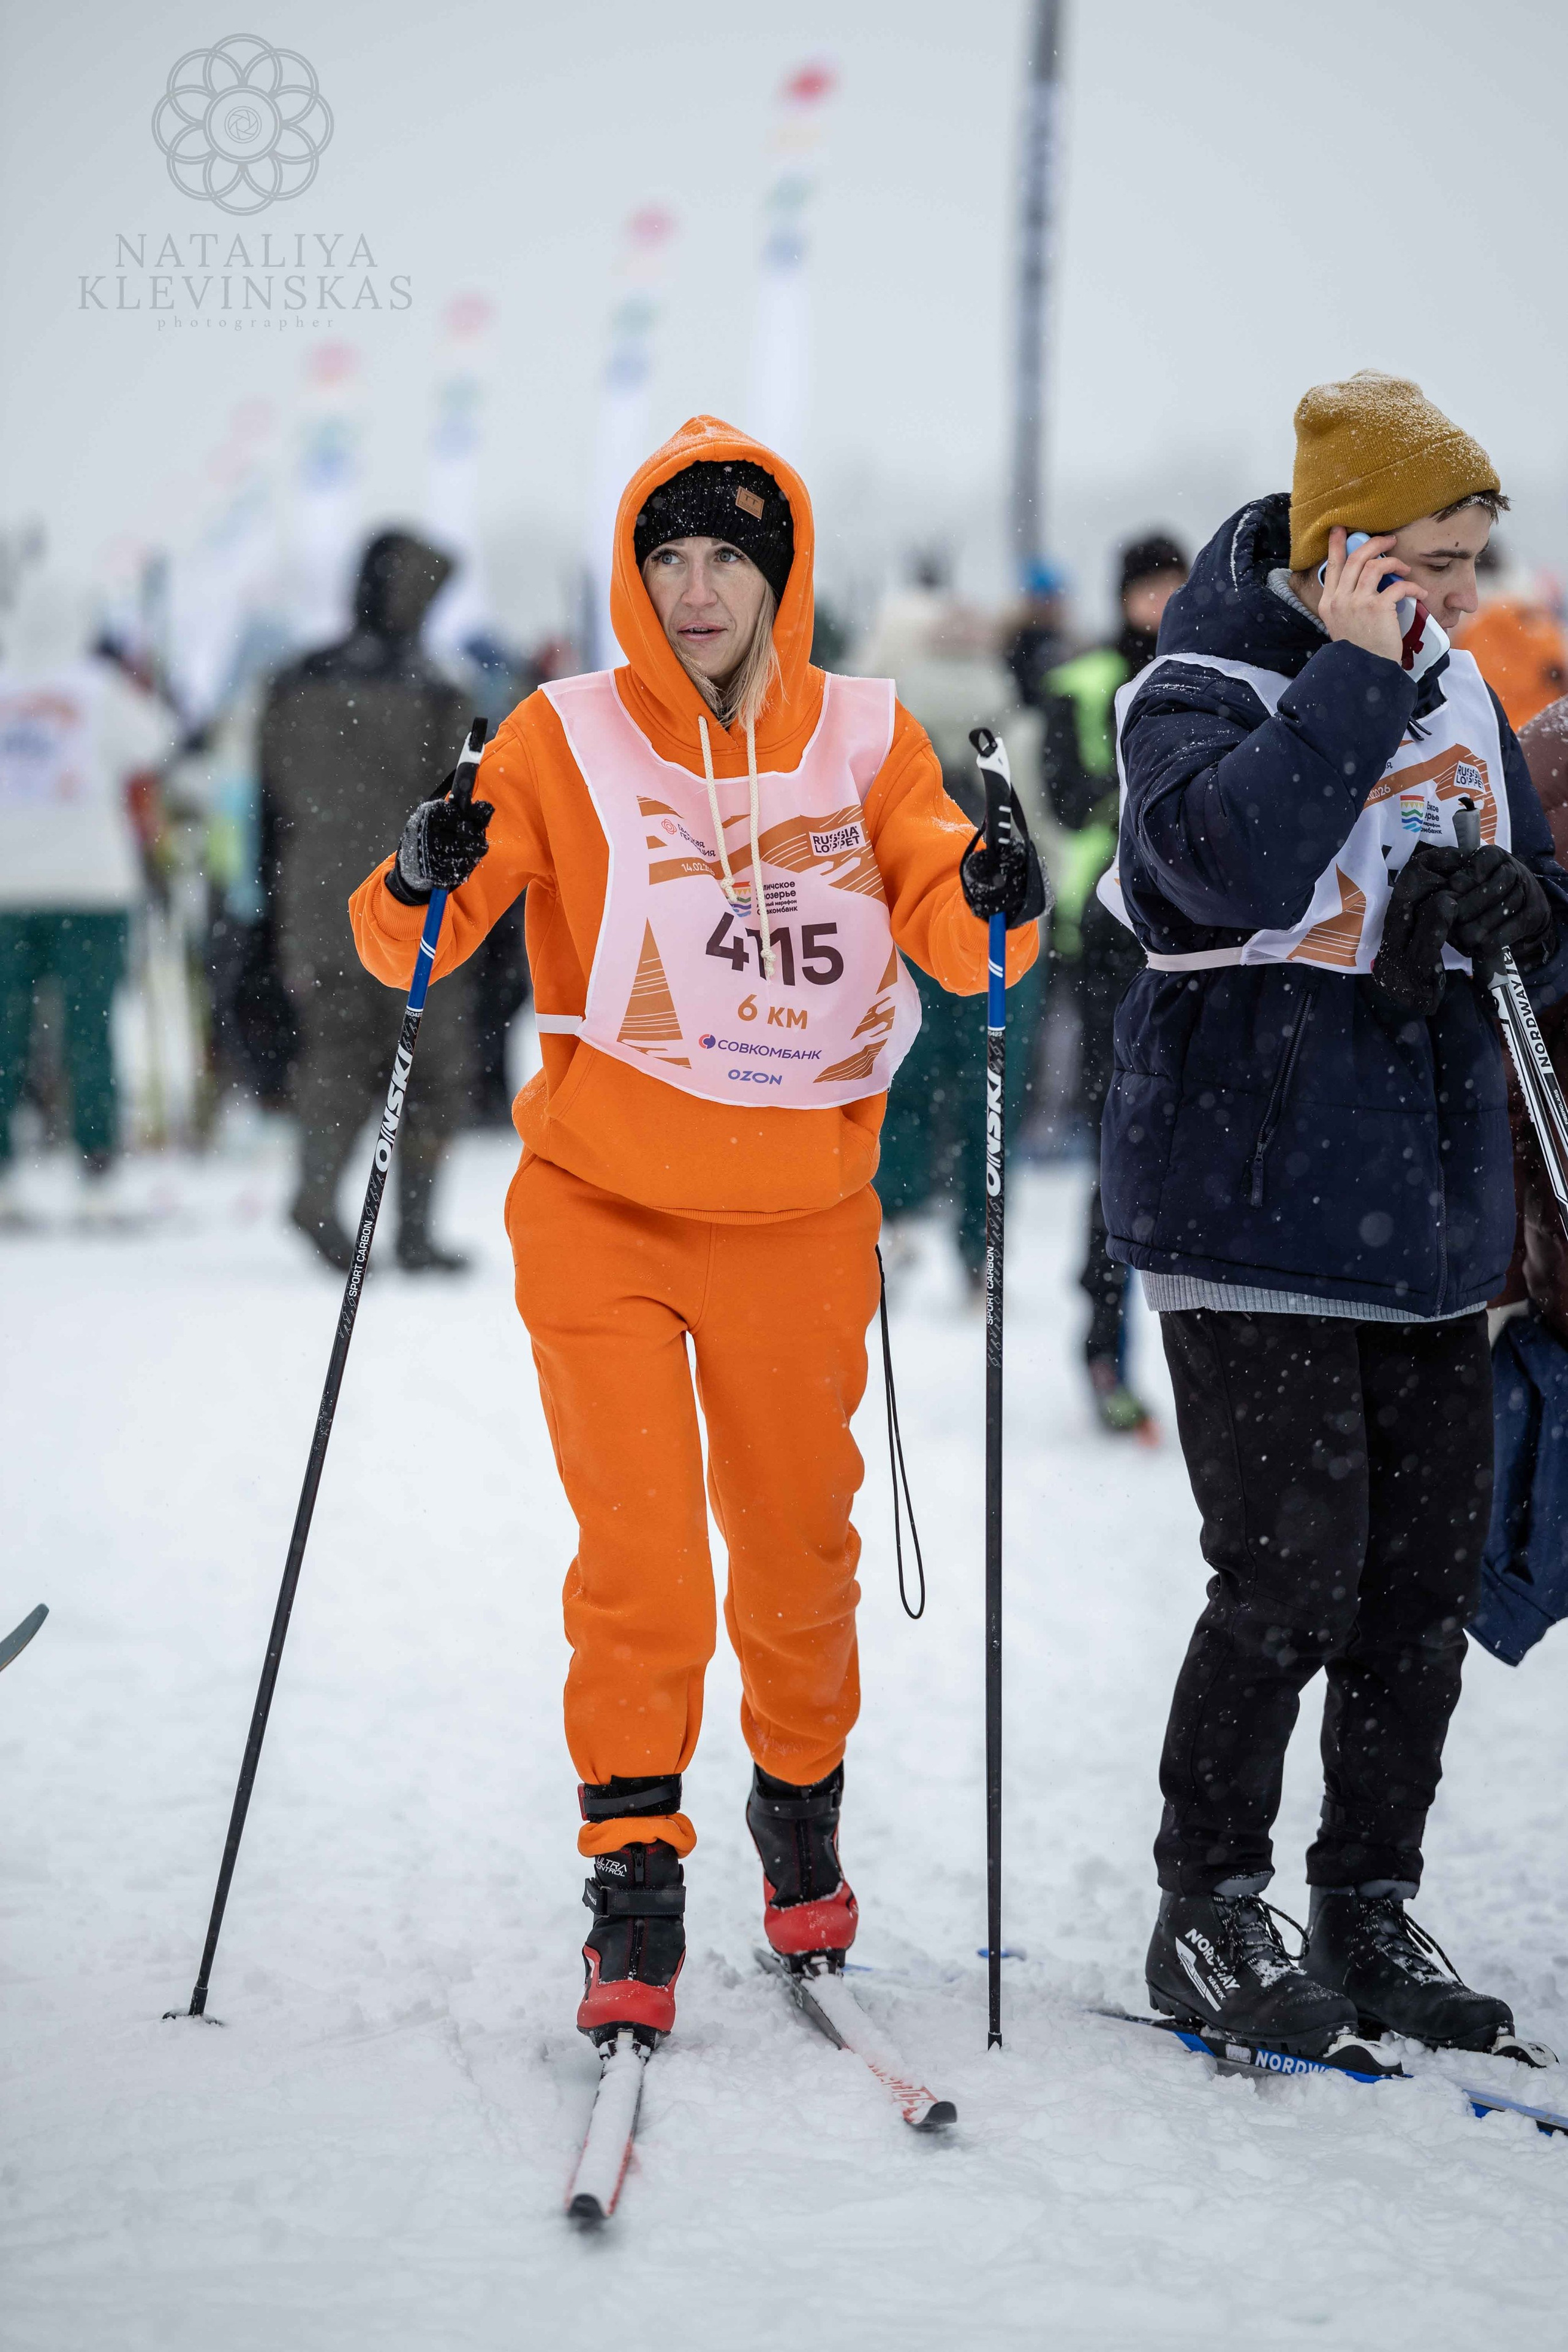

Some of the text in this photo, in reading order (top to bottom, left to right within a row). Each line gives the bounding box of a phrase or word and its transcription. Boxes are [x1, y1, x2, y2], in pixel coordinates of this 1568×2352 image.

[813, 826, 859, 845] RUSSIA
[815, 835, 861, 853] LOPPET
[756, 881, 796, 892] личское
[756, 890, 796, 900] озерье
[757, 905, 798, 916] Свкомбанк
[705, 911, 844, 986] 4115
[737, 993, 758, 1021] 6
[1511, 979, 1551, 1068] NORDWAY
[718, 1039, 823, 1060] СОВКОМБАНК
[728, 1069, 783, 1085] OZON
[349, 1219, 374, 1297] SPORT CARBON
[597, 1855, 627, 1872] ULTRA
[1207, 1975, 1227, 2001] NARVIK
[1255, 2050, 1328, 2075] NORDW
